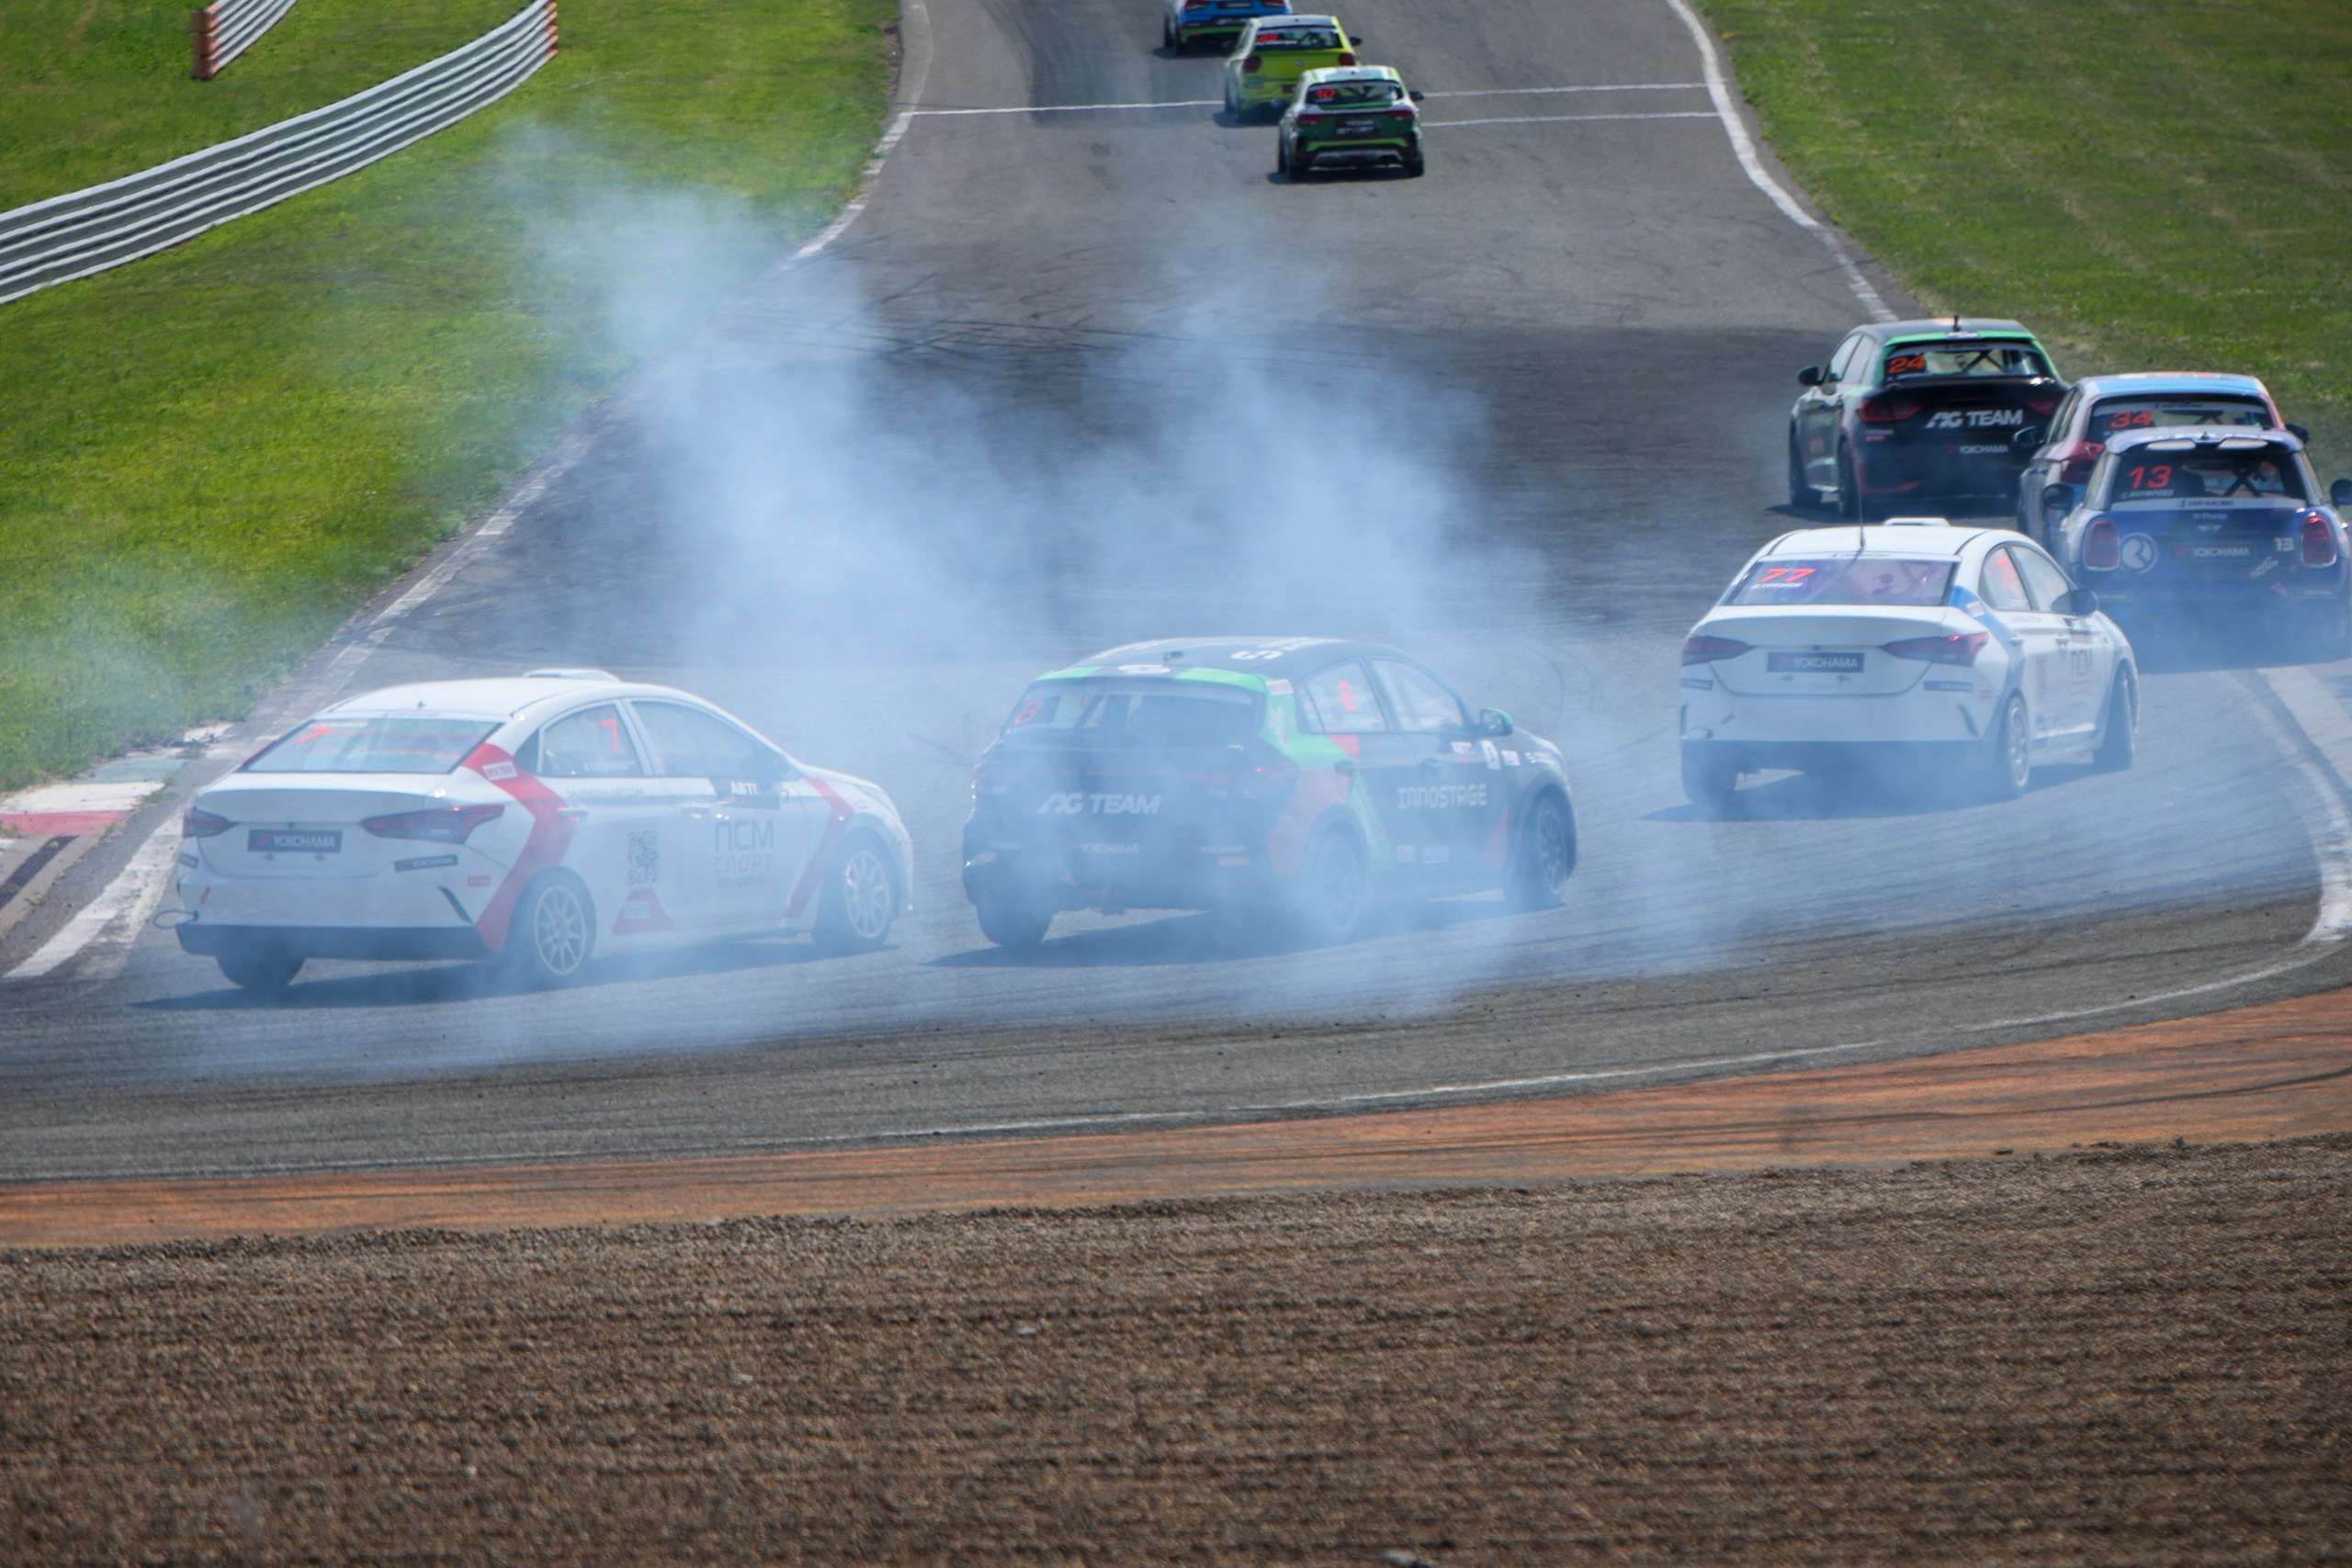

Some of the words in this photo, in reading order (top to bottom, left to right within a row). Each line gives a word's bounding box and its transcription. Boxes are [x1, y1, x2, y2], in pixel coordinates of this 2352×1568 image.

[1886, 353, 1927, 374] 24
[1968, 410, 2024, 428] TEAM
[2110, 410, 2153, 428] 34
[2128, 464, 2174, 489] 13
[2191, 547, 2250, 558] YOKOHAMA
[2274, 536, 2294, 551] 13
[1758, 568, 1816, 583] 77
[1794, 657, 1859, 670] YOKOHAMA
[1337, 681, 1357, 713] 8
[1013, 698, 1045, 725] 8
[601, 718, 618, 753] 7
[1089, 793, 1162, 815] TEAM
[1396, 783, 1487, 810] INNOSTAGE
[274, 835, 335, 848] YOKOHAMA
[714, 818, 775, 852] ПСМ
[1080, 842, 1140, 855] YOKOHAMA
[714, 853, 775, 874] СПОРТ
